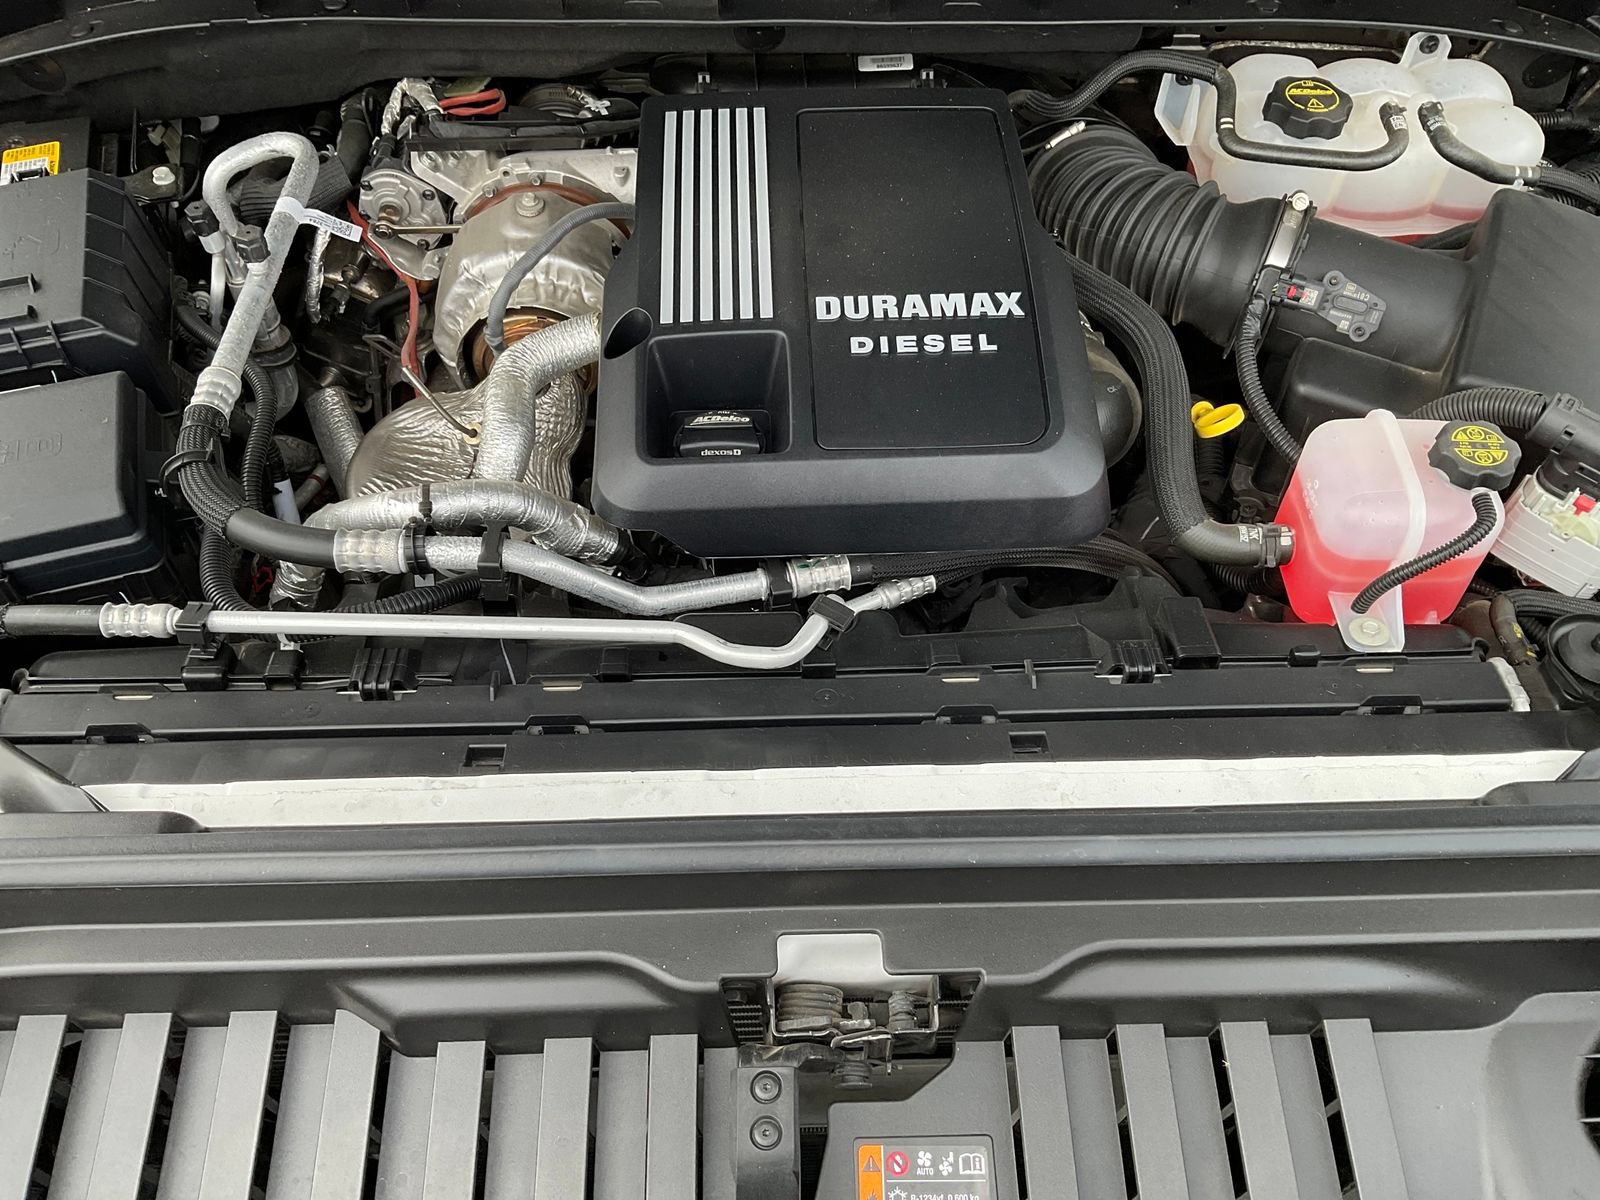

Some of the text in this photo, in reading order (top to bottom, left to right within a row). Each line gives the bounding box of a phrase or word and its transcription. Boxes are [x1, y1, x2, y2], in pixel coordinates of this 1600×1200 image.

[815, 292, 1025, 320] DURAMAX
[850, 334, 998, 354] DIESEL
[690, 415, 750, 425] ACDelco
[916, 1167, 934, 1176] AUTO
